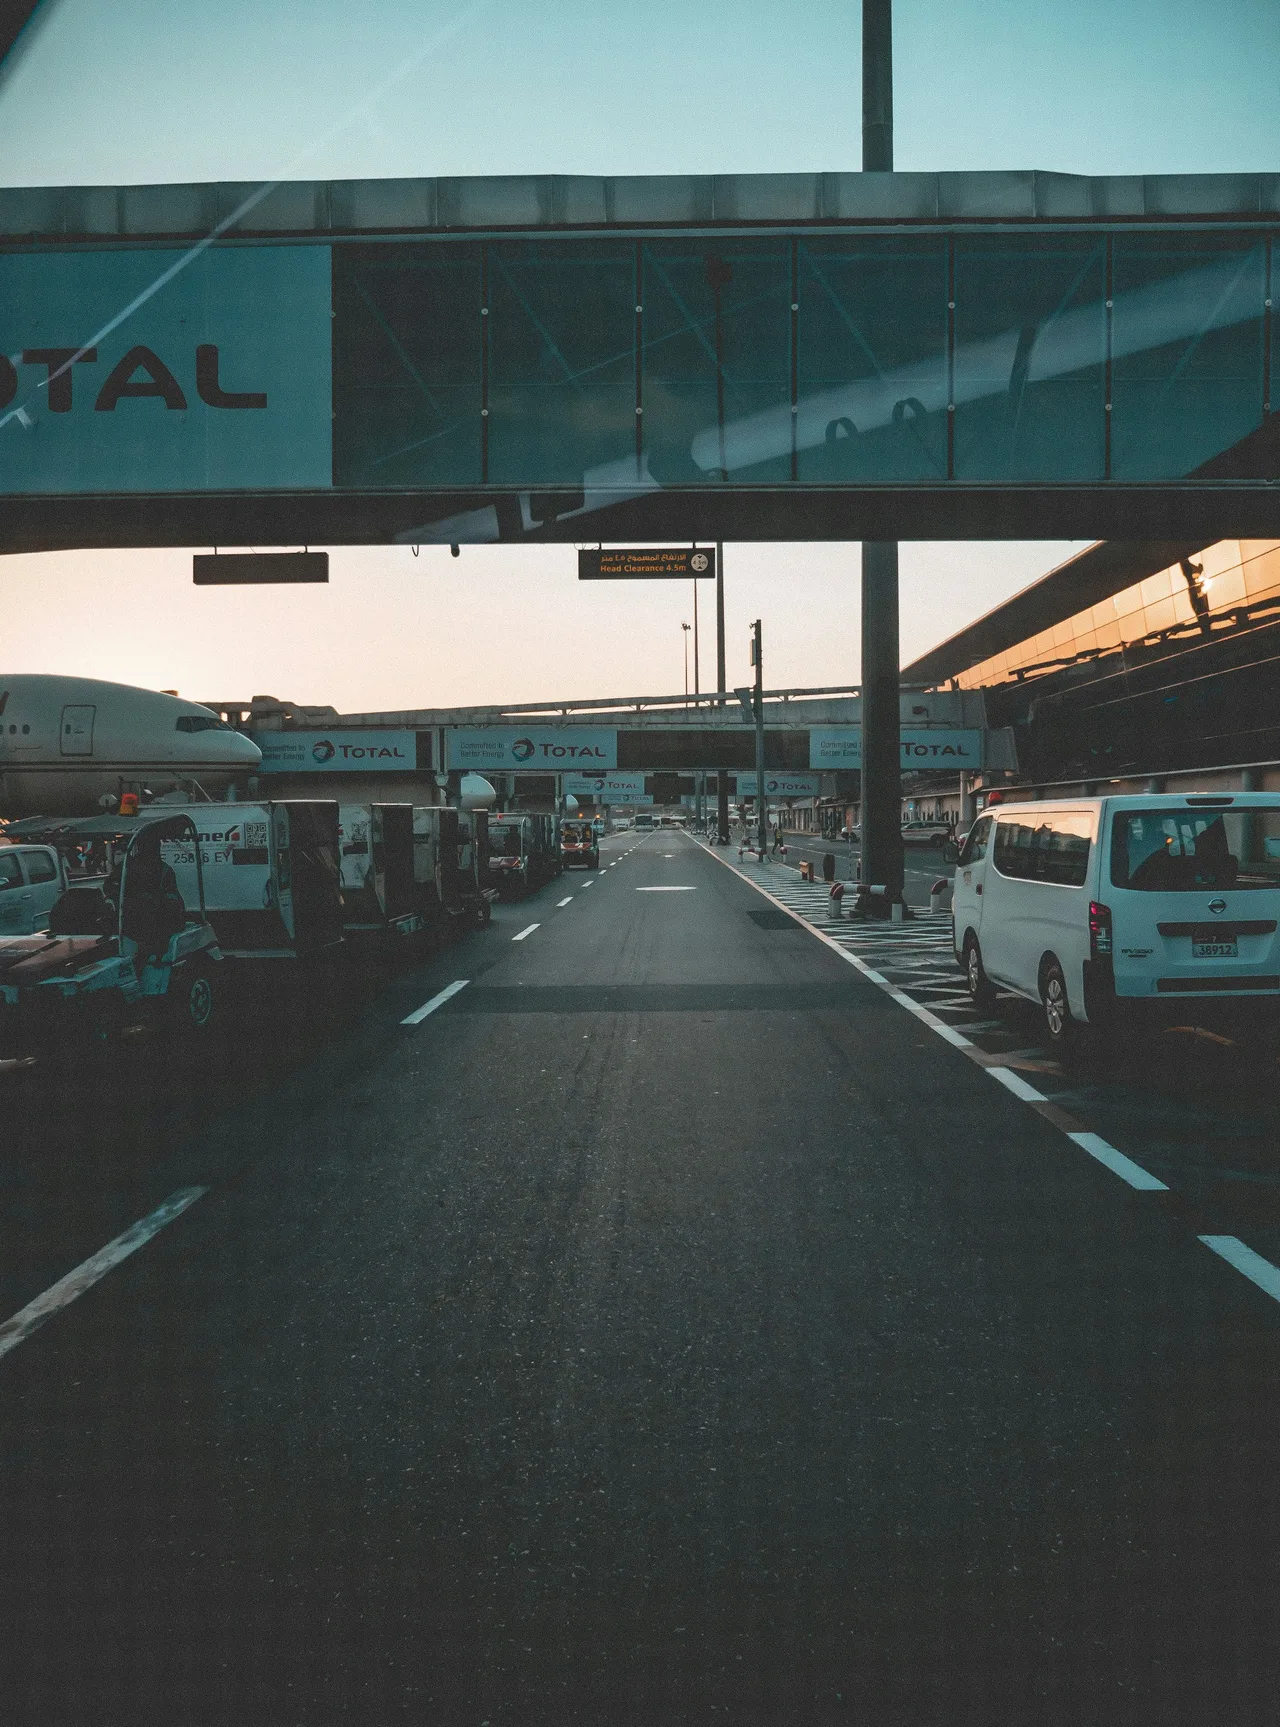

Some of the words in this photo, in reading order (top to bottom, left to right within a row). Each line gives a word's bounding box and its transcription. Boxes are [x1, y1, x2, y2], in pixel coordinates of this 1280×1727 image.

[0, 344, 267, 413] TAL
[600, 565, 622, 573] Head
[624, 564, 664, 572] Clearance
[666, 564, 687, 572] 4.5m
[820, 741, 857, 749] Committed
[901, 742, 970, 757] TOTAL
[339, 745, 405, 759] TOTAL
[539, 743, 606, 758] TOTAL
[607, 781, 639, 789] TOTAL
[780, 782, 813, 790] TOTAL
[174, 853, 209, 864] 2586
[1199, 945, 1232, 955] 38912
